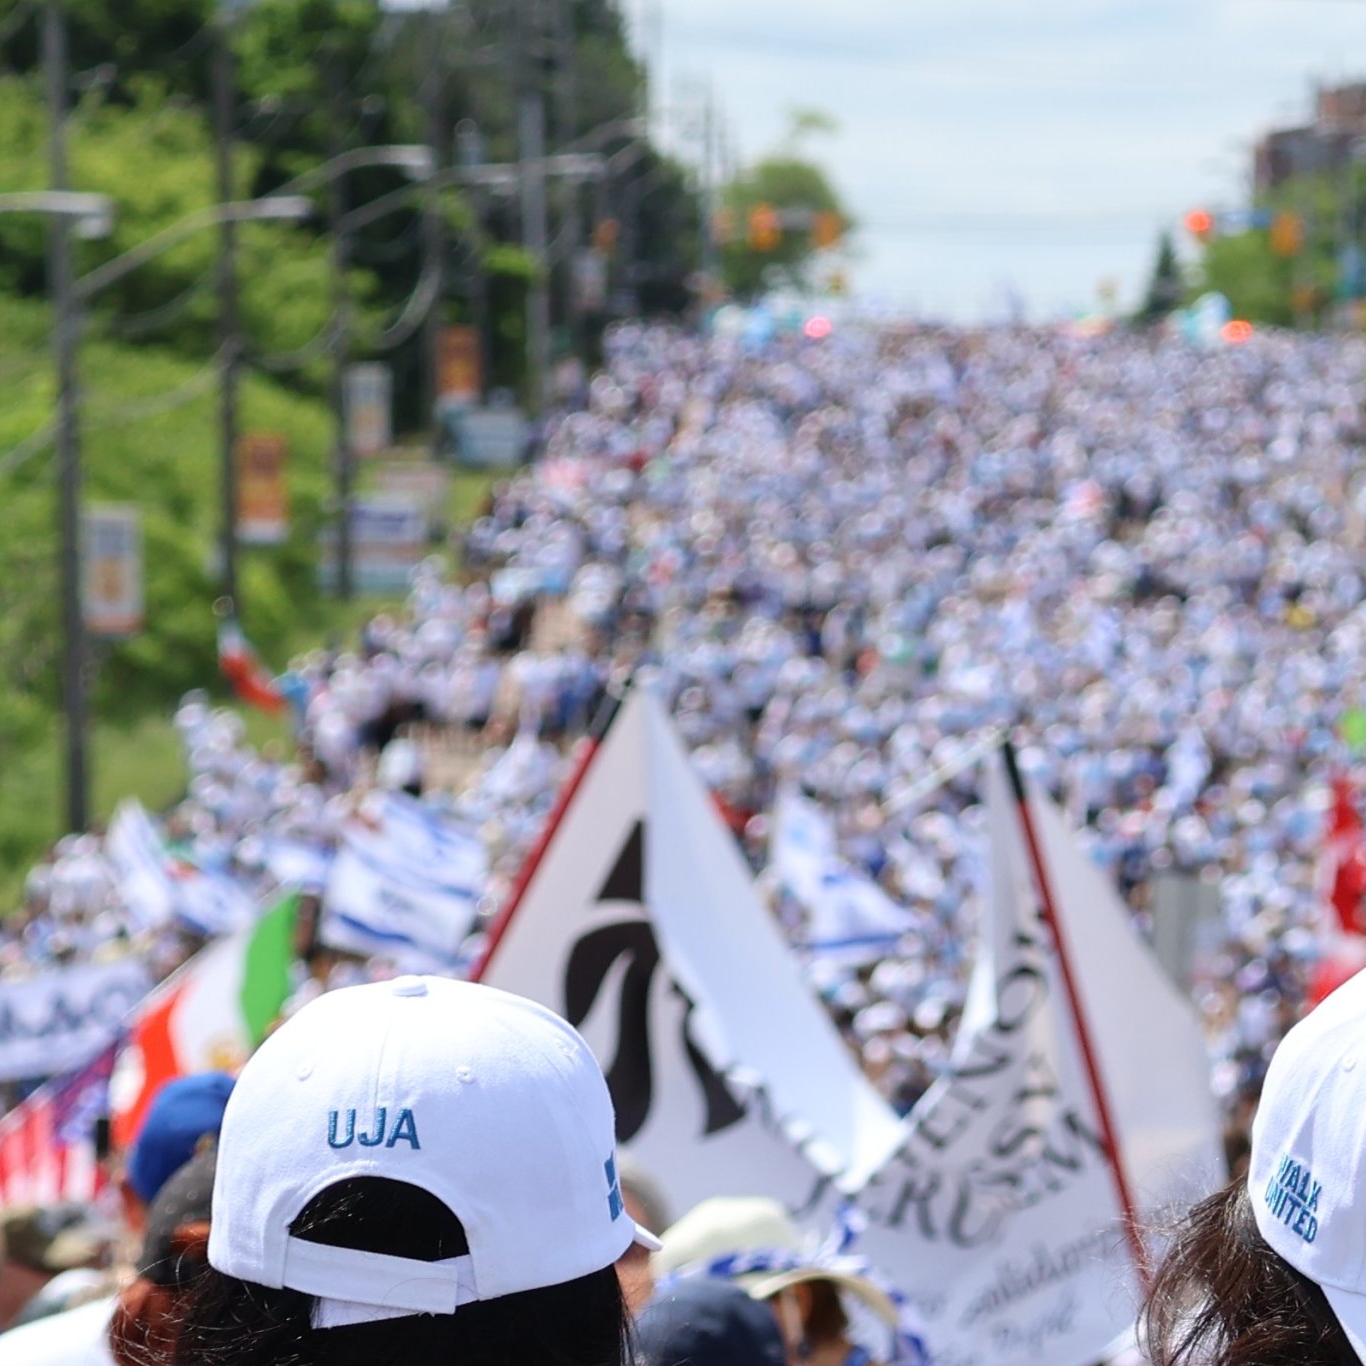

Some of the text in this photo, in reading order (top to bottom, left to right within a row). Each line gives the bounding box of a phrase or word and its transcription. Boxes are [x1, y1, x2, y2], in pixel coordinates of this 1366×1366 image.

[328, 1107, 421, 1150] UJA
[1265, 1176, 1318, 1243] UNITED
[1277, 1155, 1322, 1214] WALK
